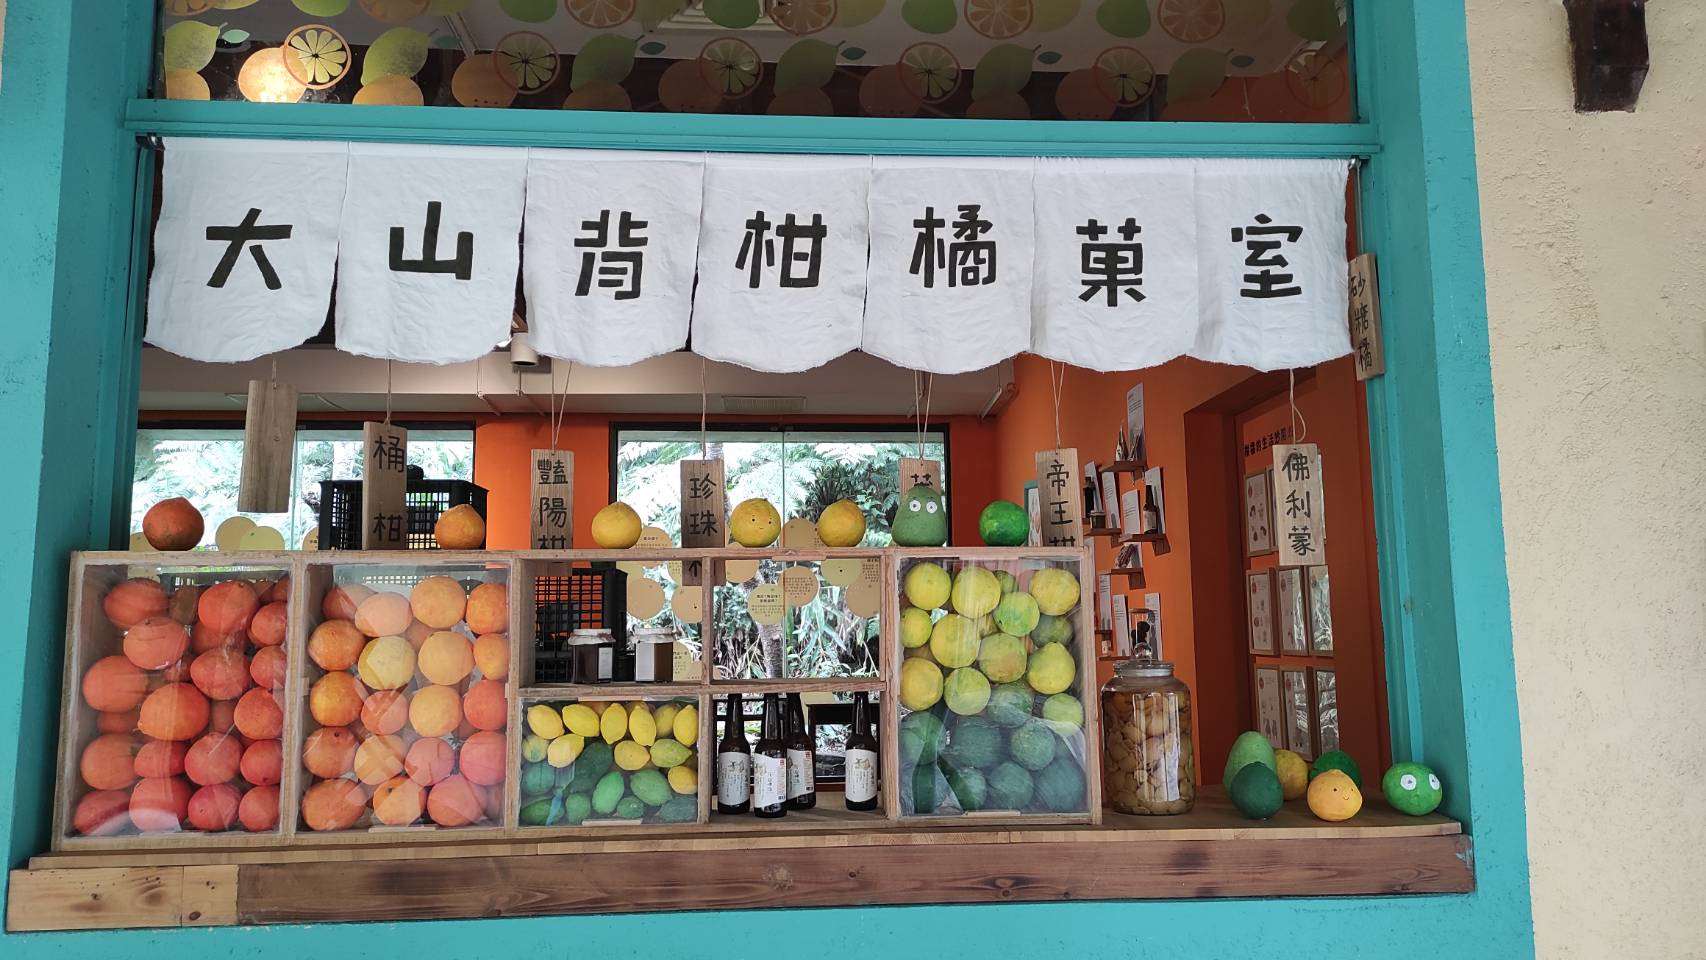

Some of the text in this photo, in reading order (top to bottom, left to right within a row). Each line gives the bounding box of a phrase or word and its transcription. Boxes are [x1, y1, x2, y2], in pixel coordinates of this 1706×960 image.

[206, 201, 1303, 306] 大山背柑橘菓室
[373, 435, 405, 542] 桶柑
[1282, 452, 1316, 556] 佛利蒙
